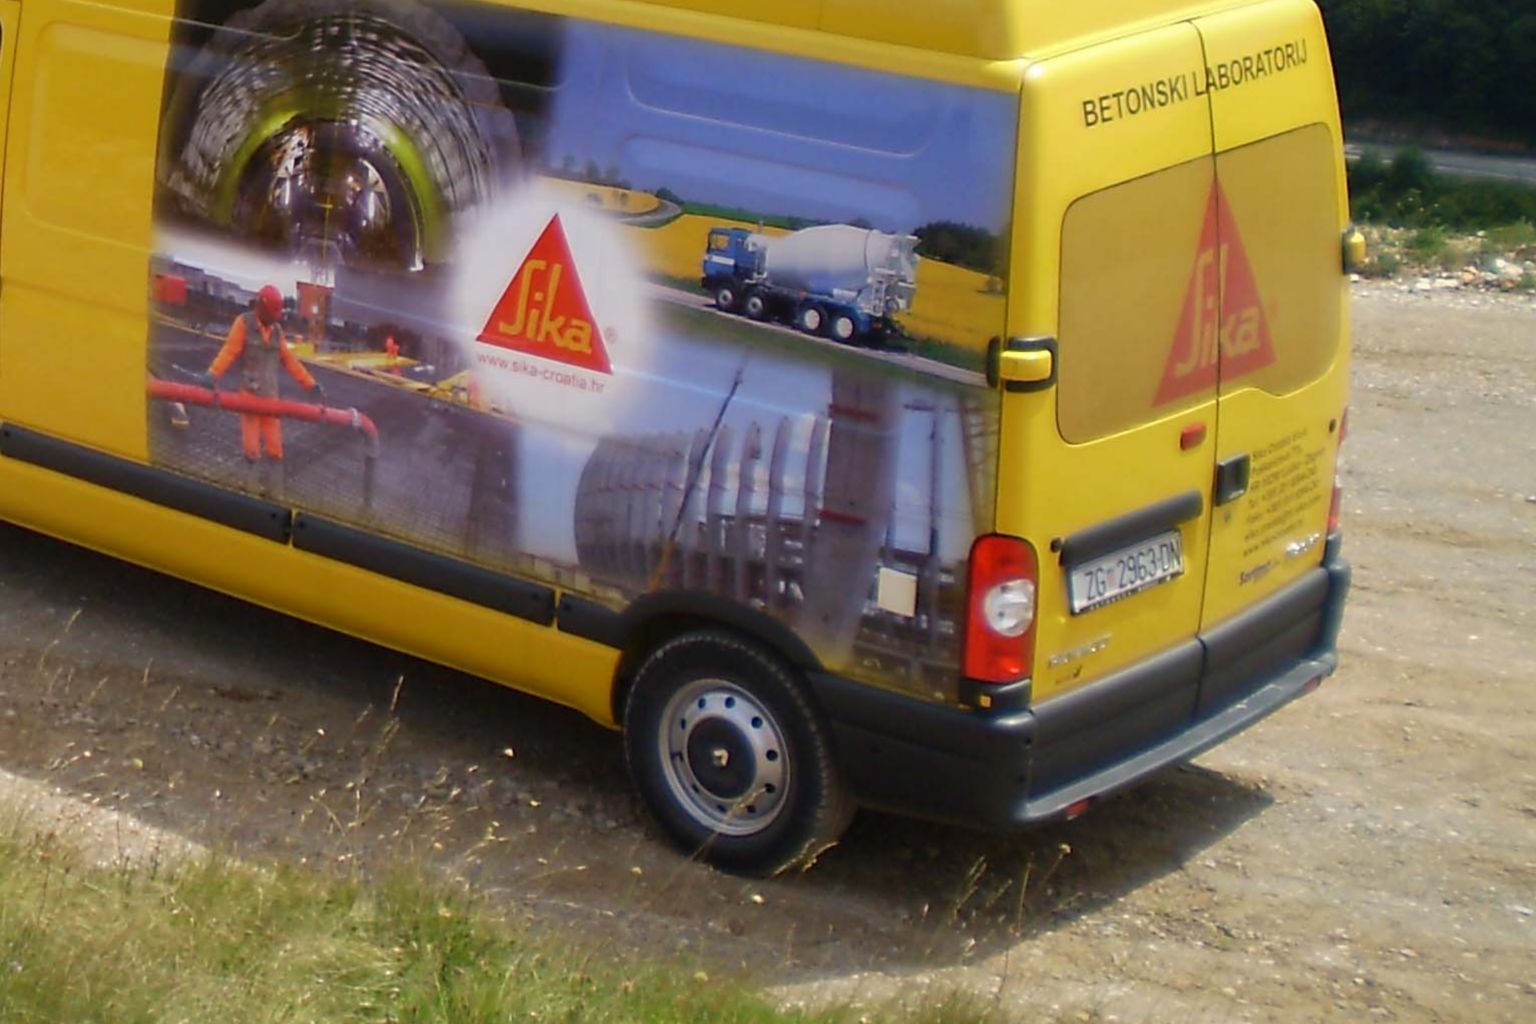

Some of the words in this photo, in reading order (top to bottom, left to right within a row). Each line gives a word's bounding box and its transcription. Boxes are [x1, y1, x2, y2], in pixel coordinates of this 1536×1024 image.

[1082, 76, 1189, 128] BETONSKI
[1192, 39, 1308, 97] LABORATORIJ
[498, 258, 593, 355] Sika
[1172, 242, 1262, 378] Sika
[476, 352, 606, 394] www.sika-croatia.hr
